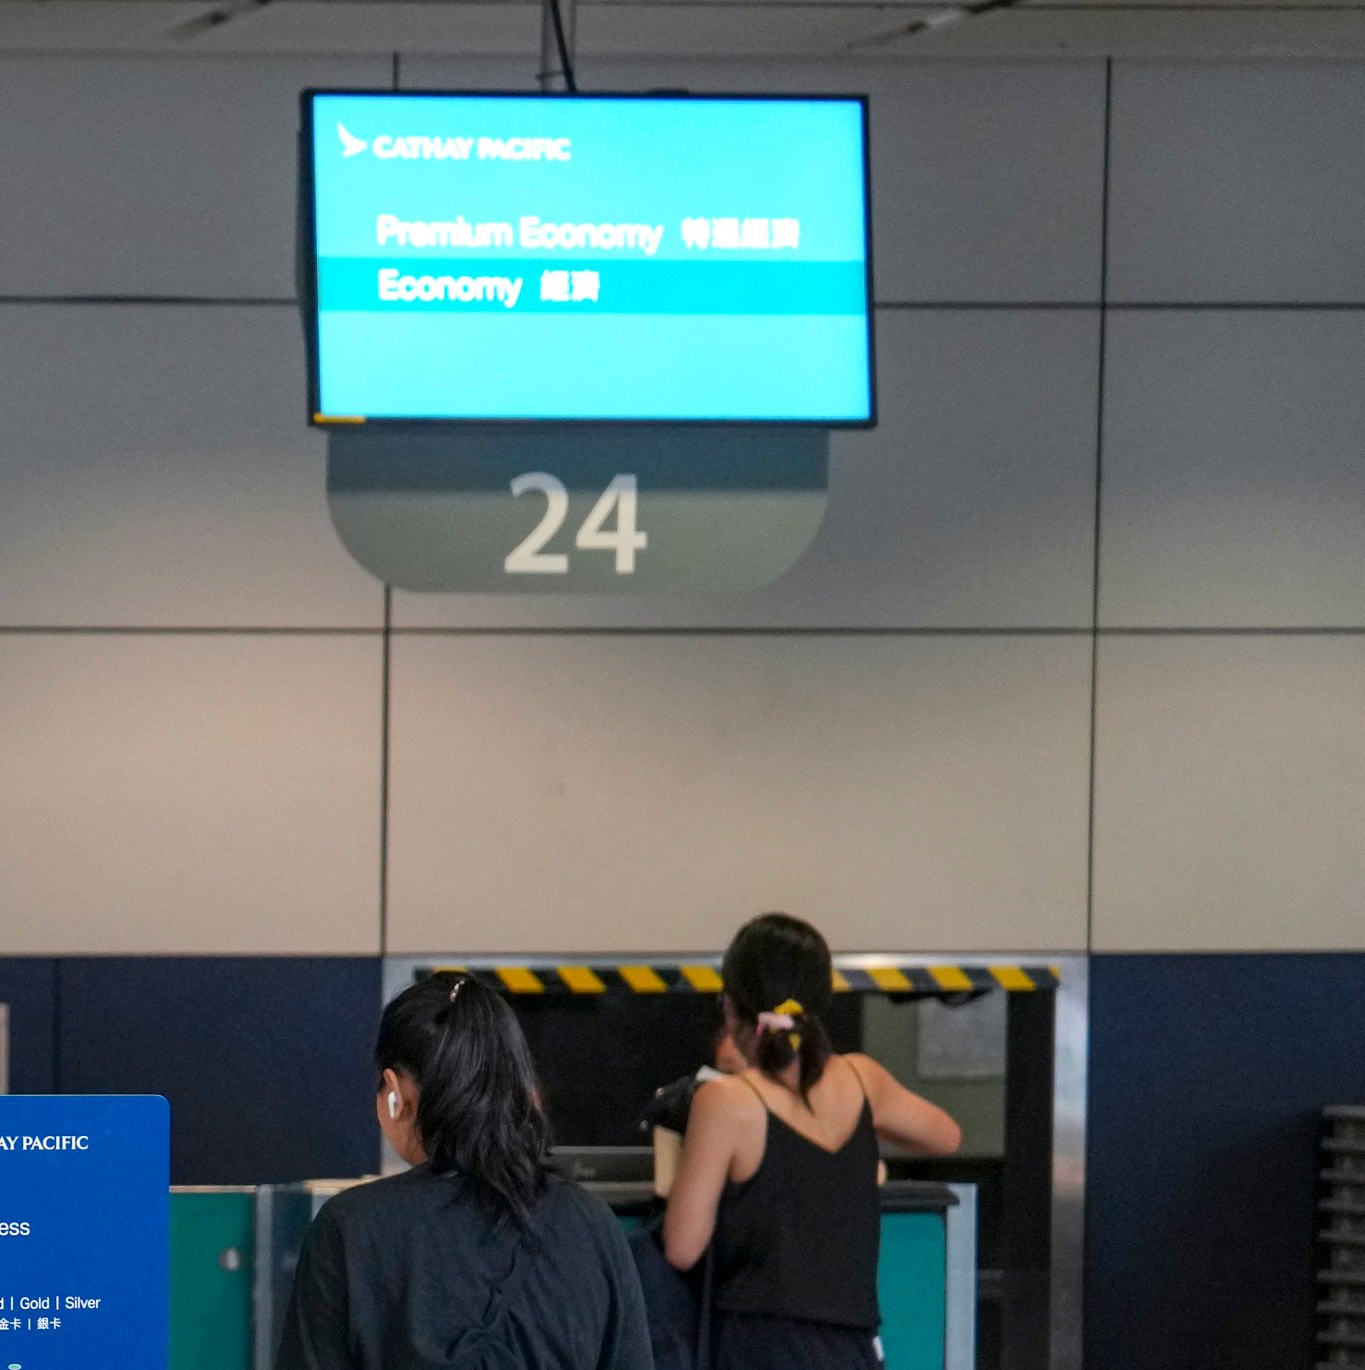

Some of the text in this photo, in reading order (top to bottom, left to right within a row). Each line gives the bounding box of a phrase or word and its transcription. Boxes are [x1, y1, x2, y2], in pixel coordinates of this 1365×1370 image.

[372, 136, 571, 161] CATHAY PACIFIC
[377, 214, 513, 247] Premium
[519, 216, 663, 255] Economy
[378, 269, 523, 308] Economy
[504, 472, 648, 575] 24
[23, 1136, 88, 1150] PACIFIC
[20, 1297, 49, 1309] Gold
[66, 1297, 101, 1309] Silver
[38, 1317, 61, 1329] 銀卡
